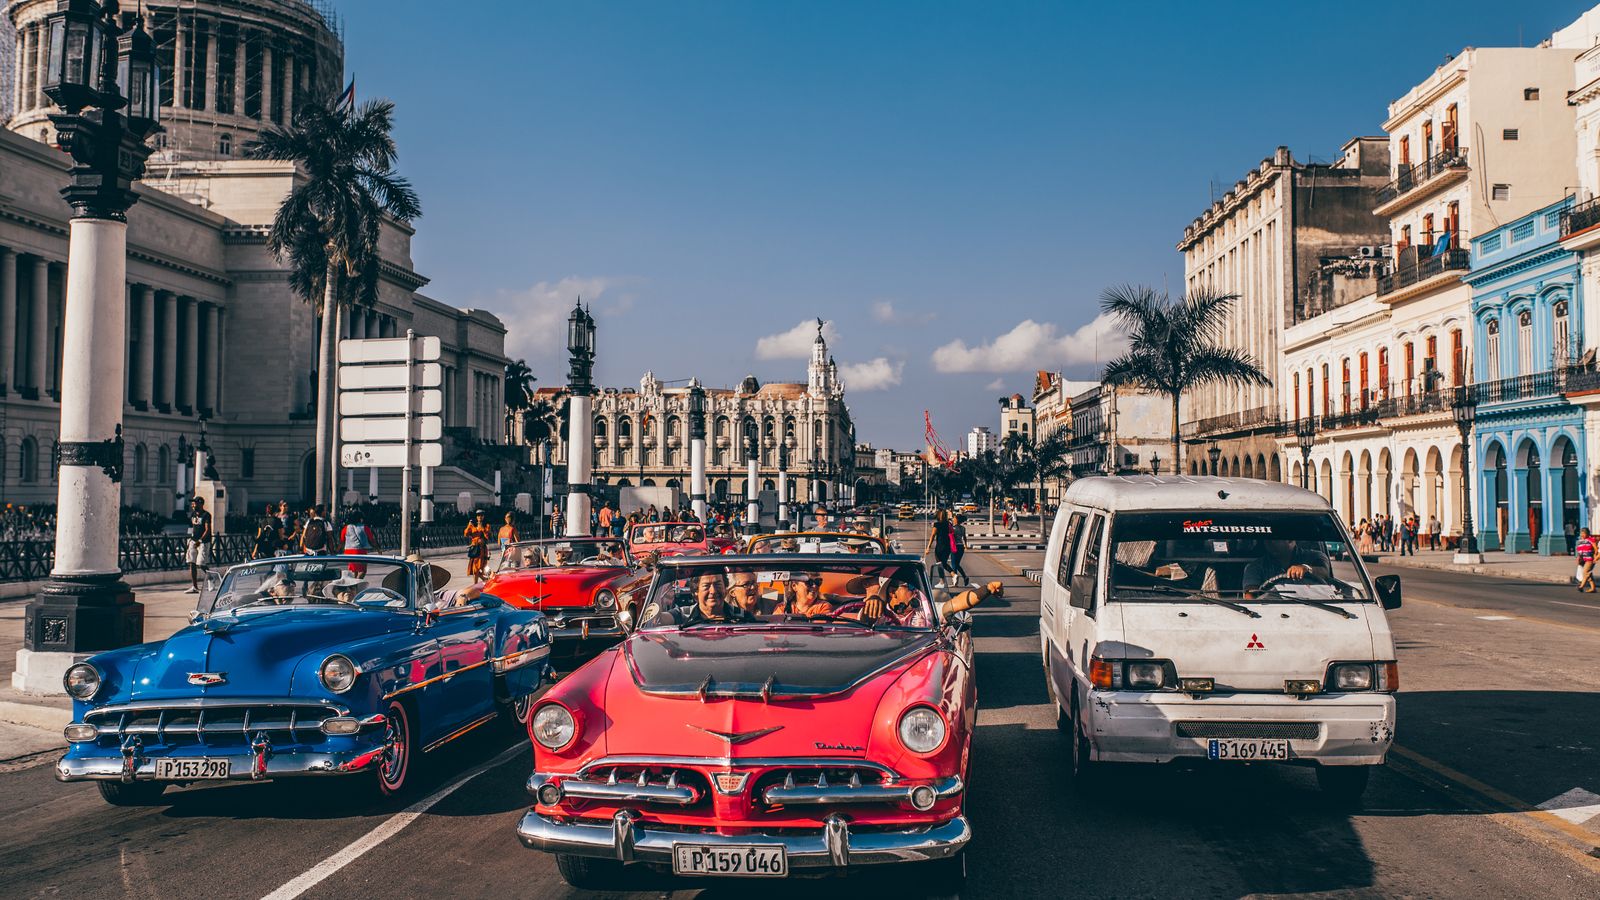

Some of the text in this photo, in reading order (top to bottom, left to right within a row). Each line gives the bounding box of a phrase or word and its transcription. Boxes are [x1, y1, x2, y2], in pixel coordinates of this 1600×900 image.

[240, 568, 257, 576] TAXI
[772, 572, 782, 580] 17
[1260, 743, 1286, 758] 445
[201, 762, 226, 777] 298
